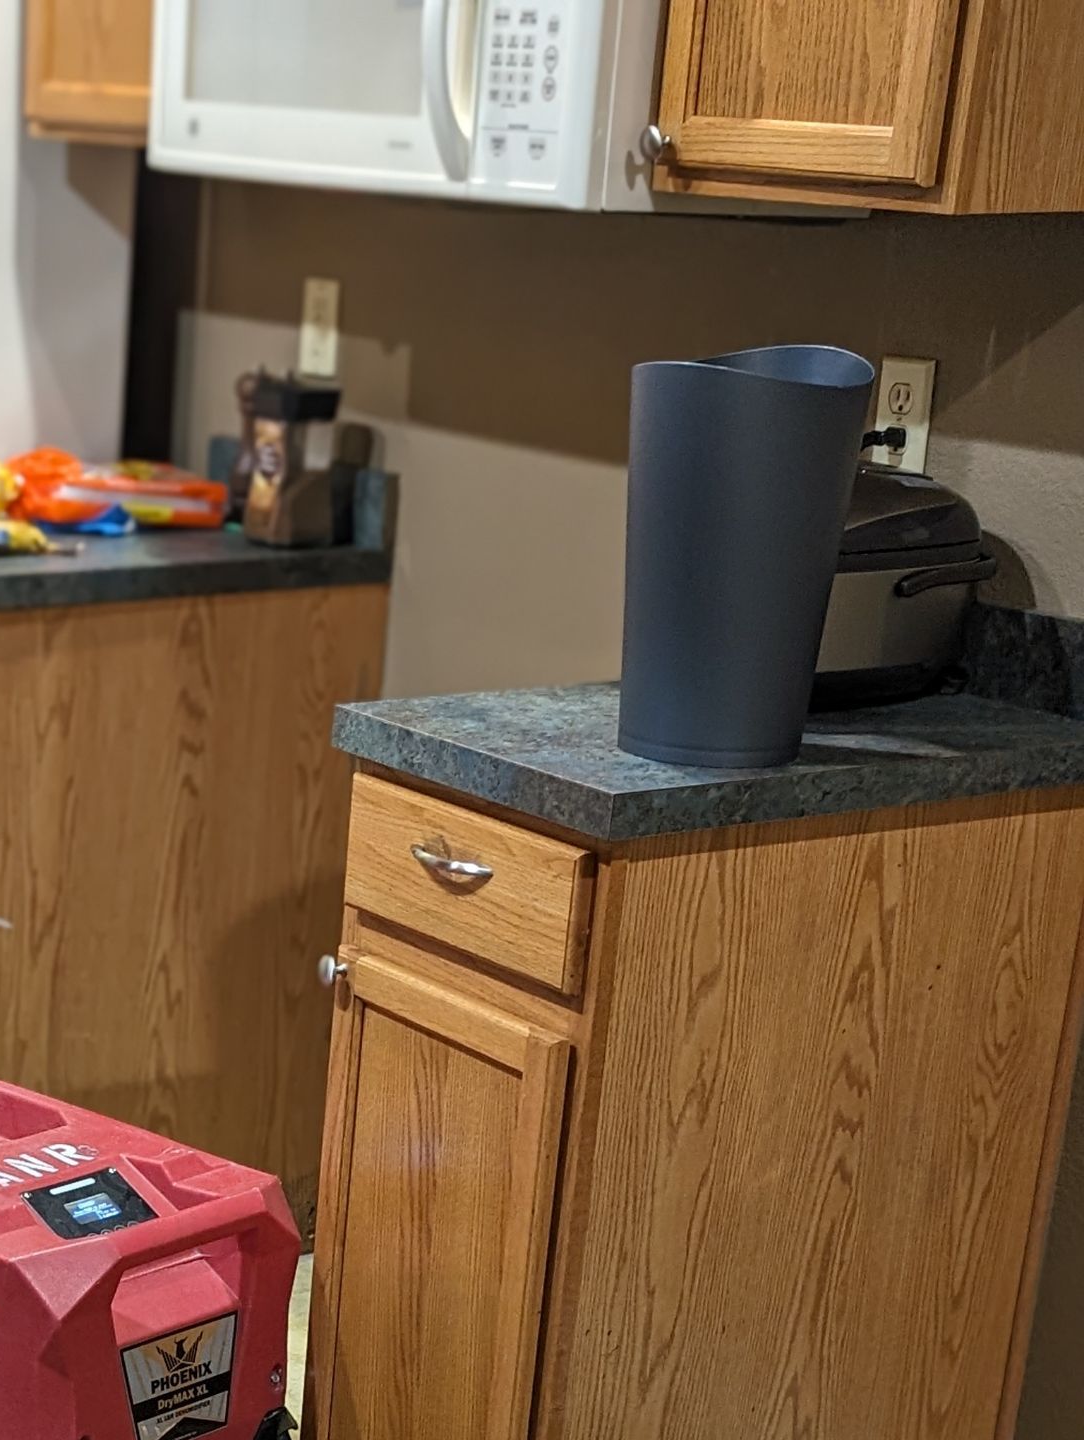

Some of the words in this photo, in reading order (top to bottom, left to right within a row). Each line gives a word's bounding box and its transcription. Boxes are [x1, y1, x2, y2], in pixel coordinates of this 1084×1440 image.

[151, 1360, 212, 1394] PHOENIX
[157, 1388, 195, 1411] DryMAX
[196, 1383, 209, 1397] XL
